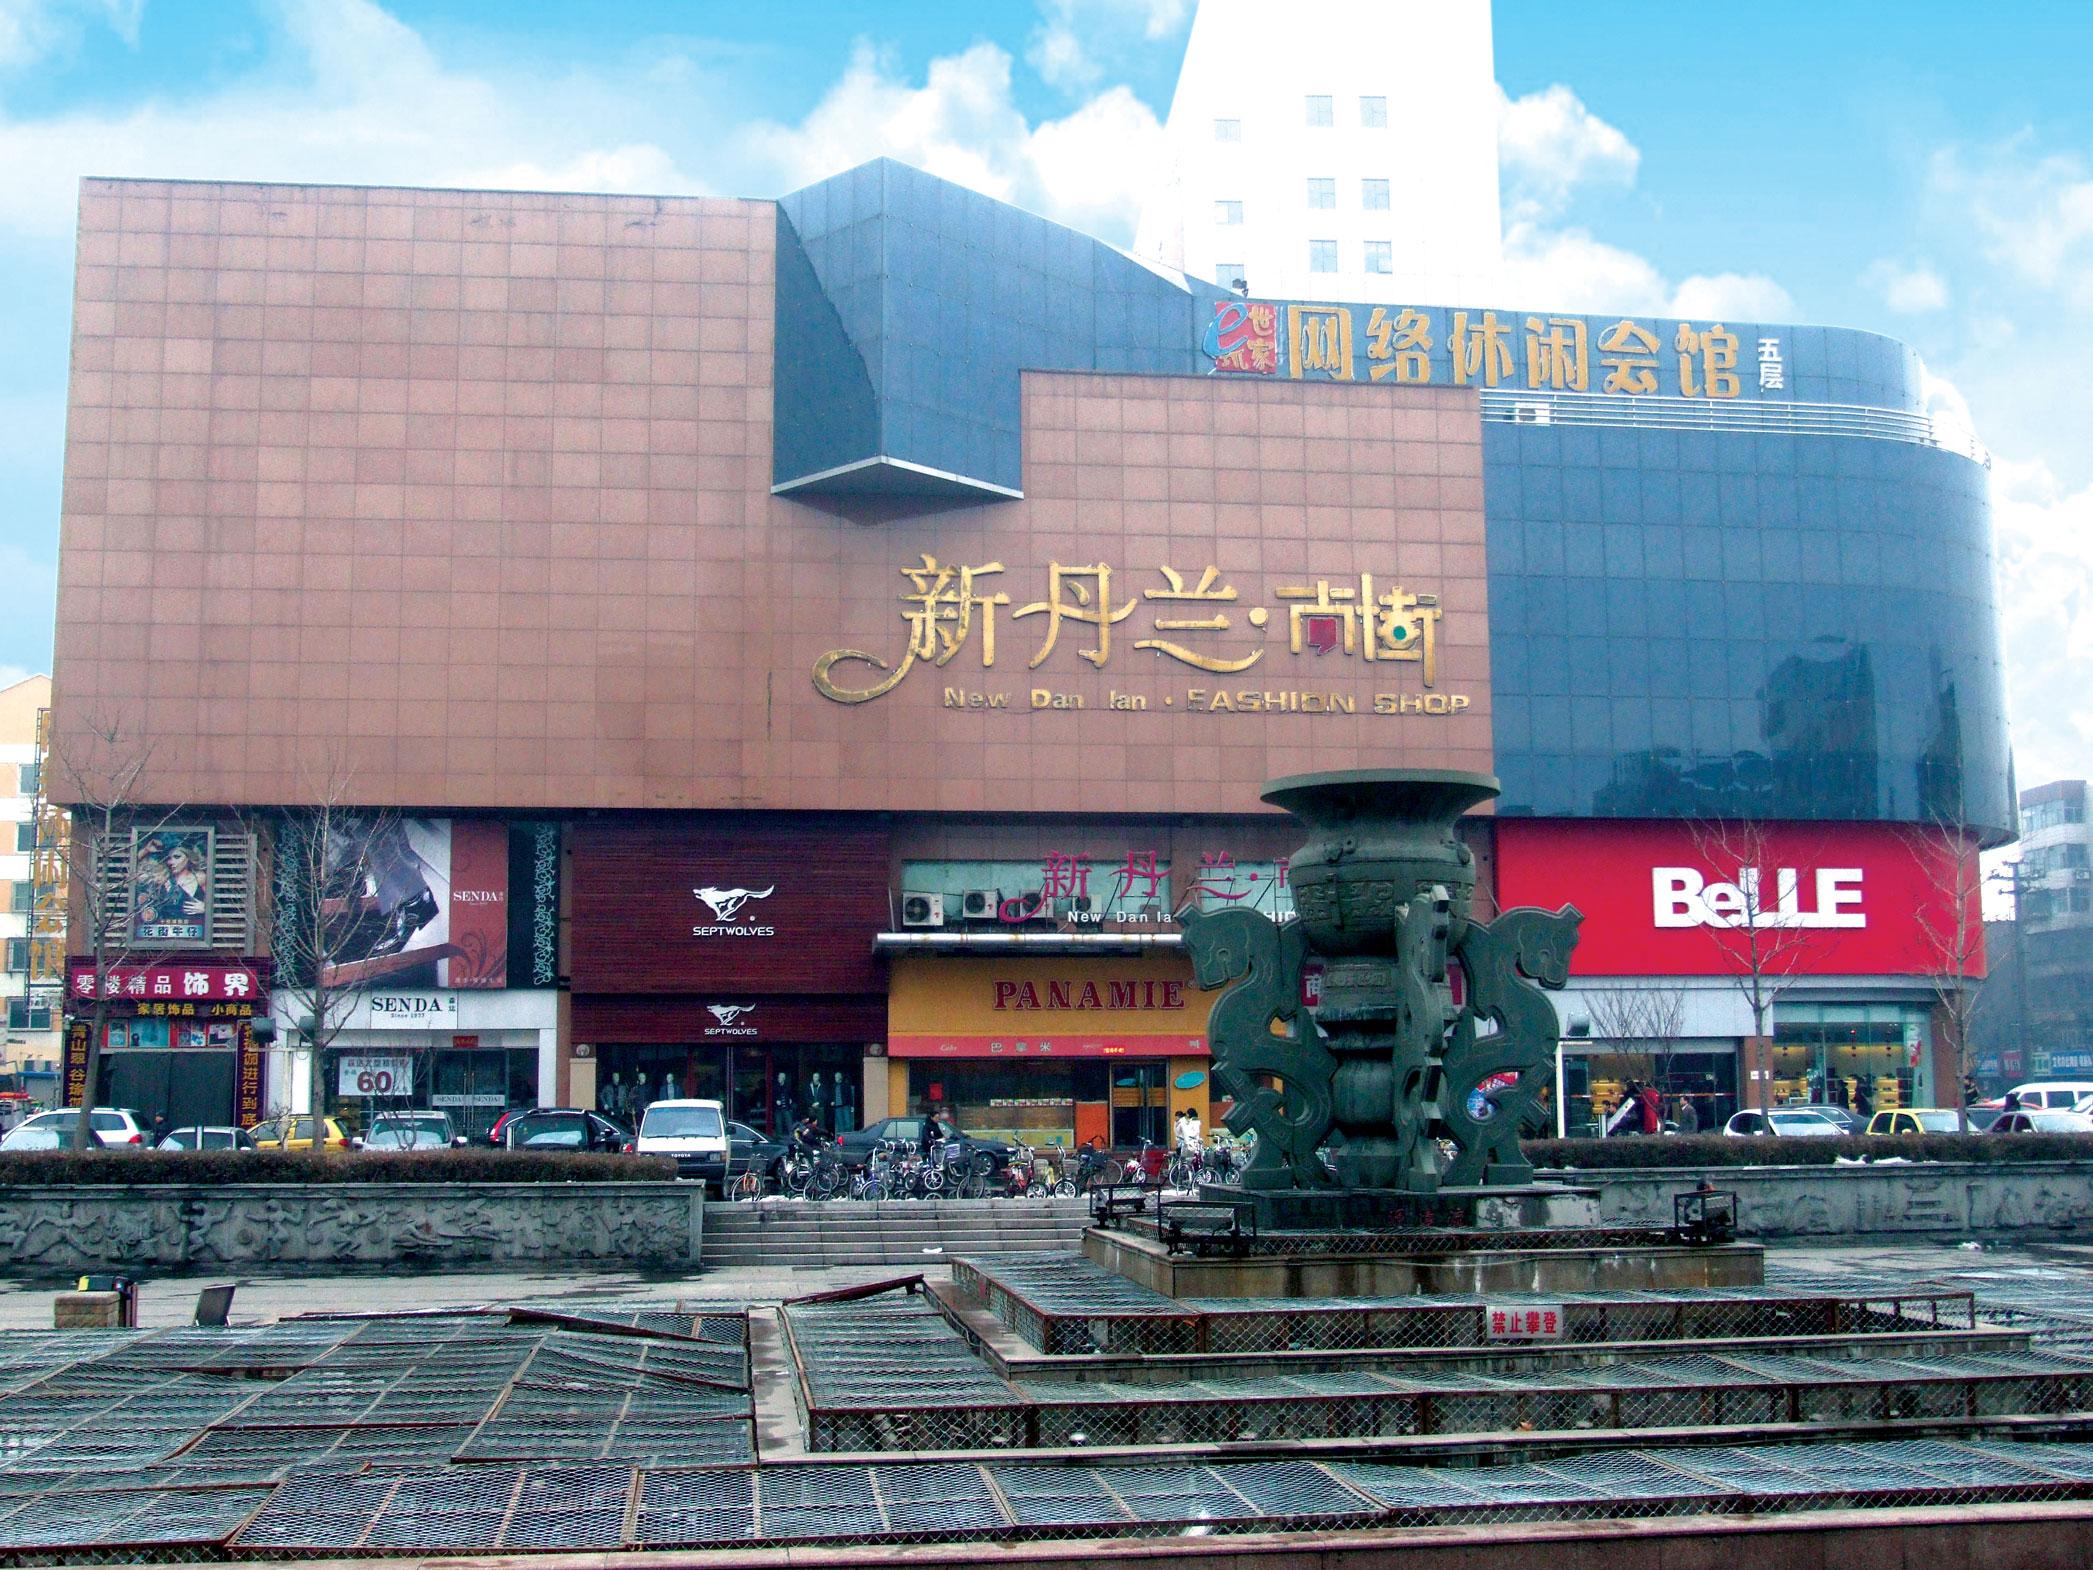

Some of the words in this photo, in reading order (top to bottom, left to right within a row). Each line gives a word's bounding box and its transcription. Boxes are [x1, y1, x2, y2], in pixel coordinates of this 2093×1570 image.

[1287, 304, 1741, 398] 网络休闲会馆
[1758, 338, 1784, 389] 五层
[943, 687, 1009, 709] New
[1031, 688, 1084, 710] Dan
[1187, 689, 1355, 714] FASHION
[1374, 692, 1470, 715] SHOP
[453, 891, 498, 902] SENDA
[1067, 910, 1102, 924] New
[1116, 910, 1148, 924] Dan
[1157, 910, 1172, 924] la
[692, 926, 775, 937] SEPTWOLVES
[993, 979, 1187, 1011] PANAMIE
[137, 1003, 195, 1016] 家居饰品
[211, 1003, 252, 1016] 小商品
[372, 997, 443, 1012] SENDA
[704, 1028, 758, 1036] SEPTWOLVES
[357, 1071, 393, 1093] 60
[1491, 1311, 1557, 1334] 禁止攀登
